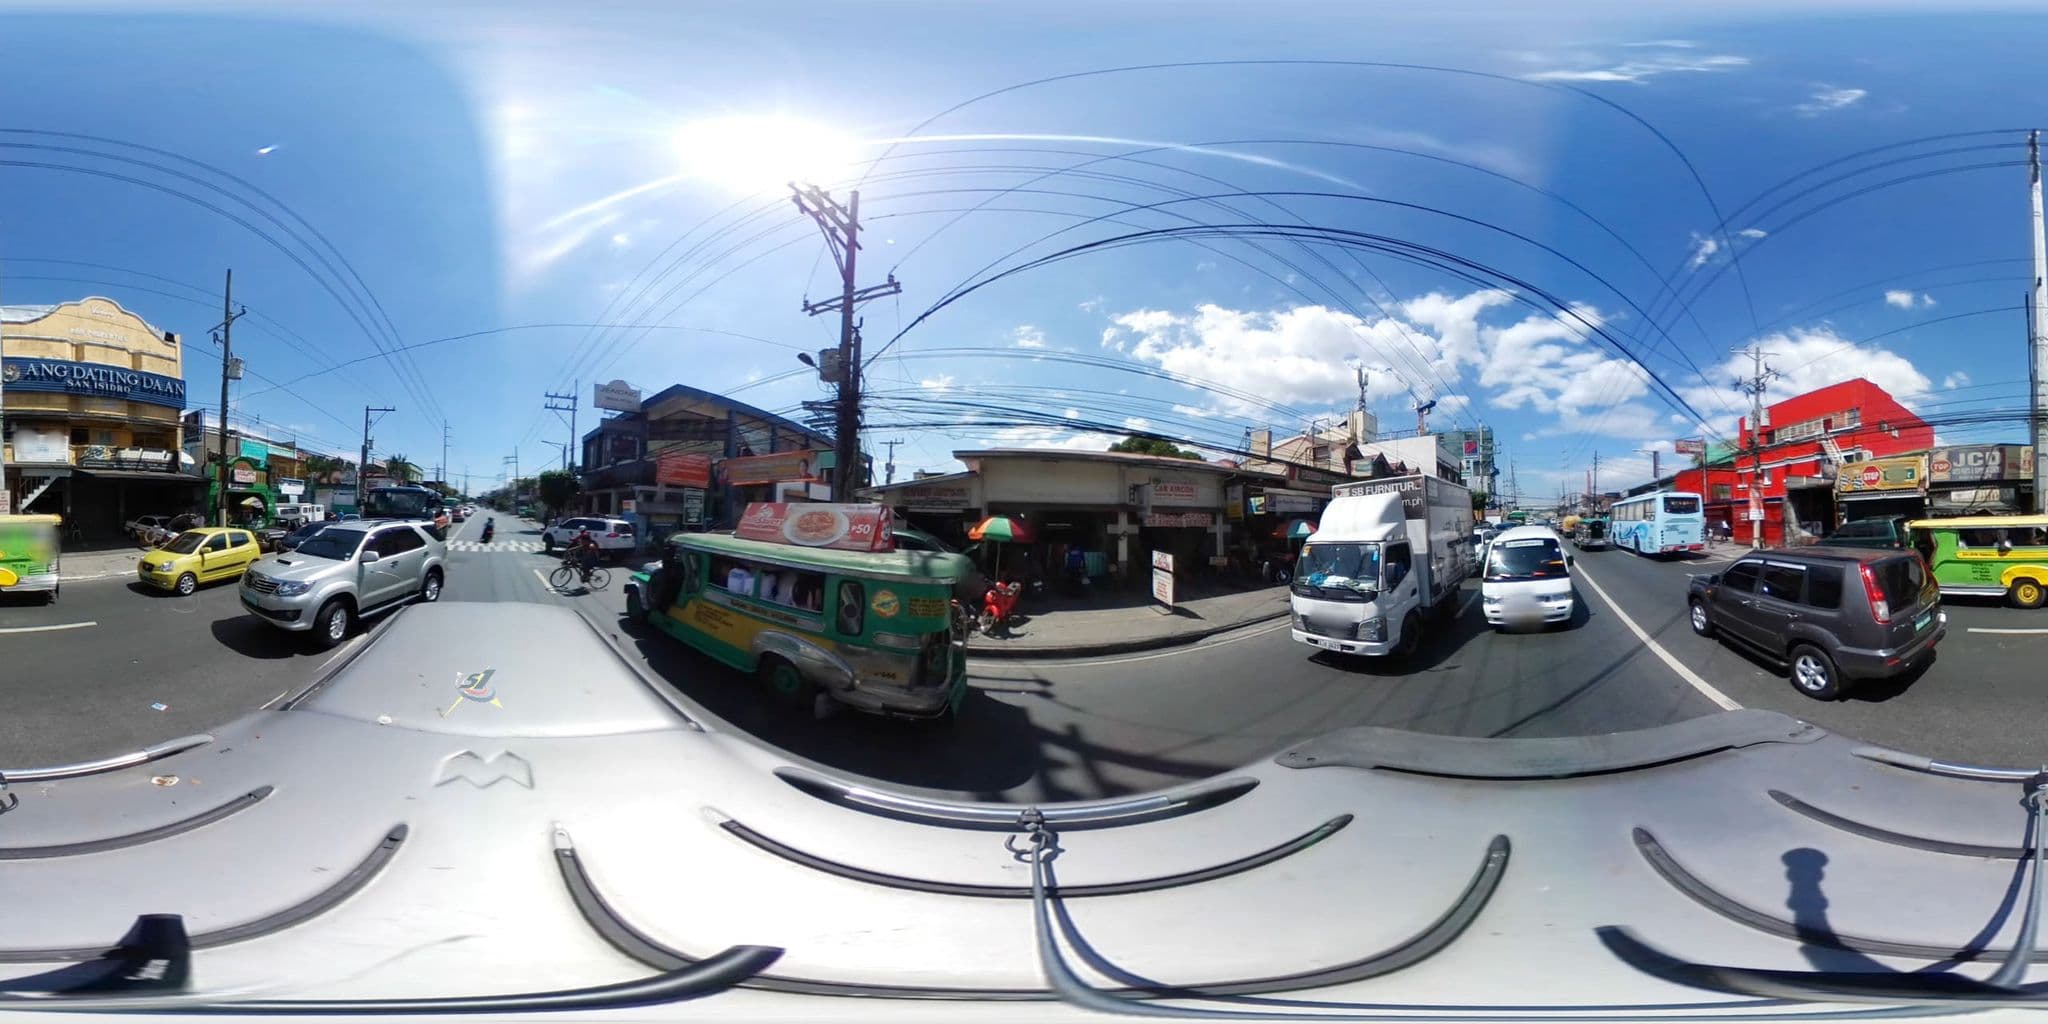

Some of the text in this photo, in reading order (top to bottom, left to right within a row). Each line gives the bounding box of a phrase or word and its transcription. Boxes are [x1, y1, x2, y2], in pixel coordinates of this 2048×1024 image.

[26, 363, 184, 395] ANG DATING DAAN
[67, 380, 131, 394] SAN ISIDRO
[1864, 471, 1880, 481] STOP
[1352, 487, 1364, 496] SB
